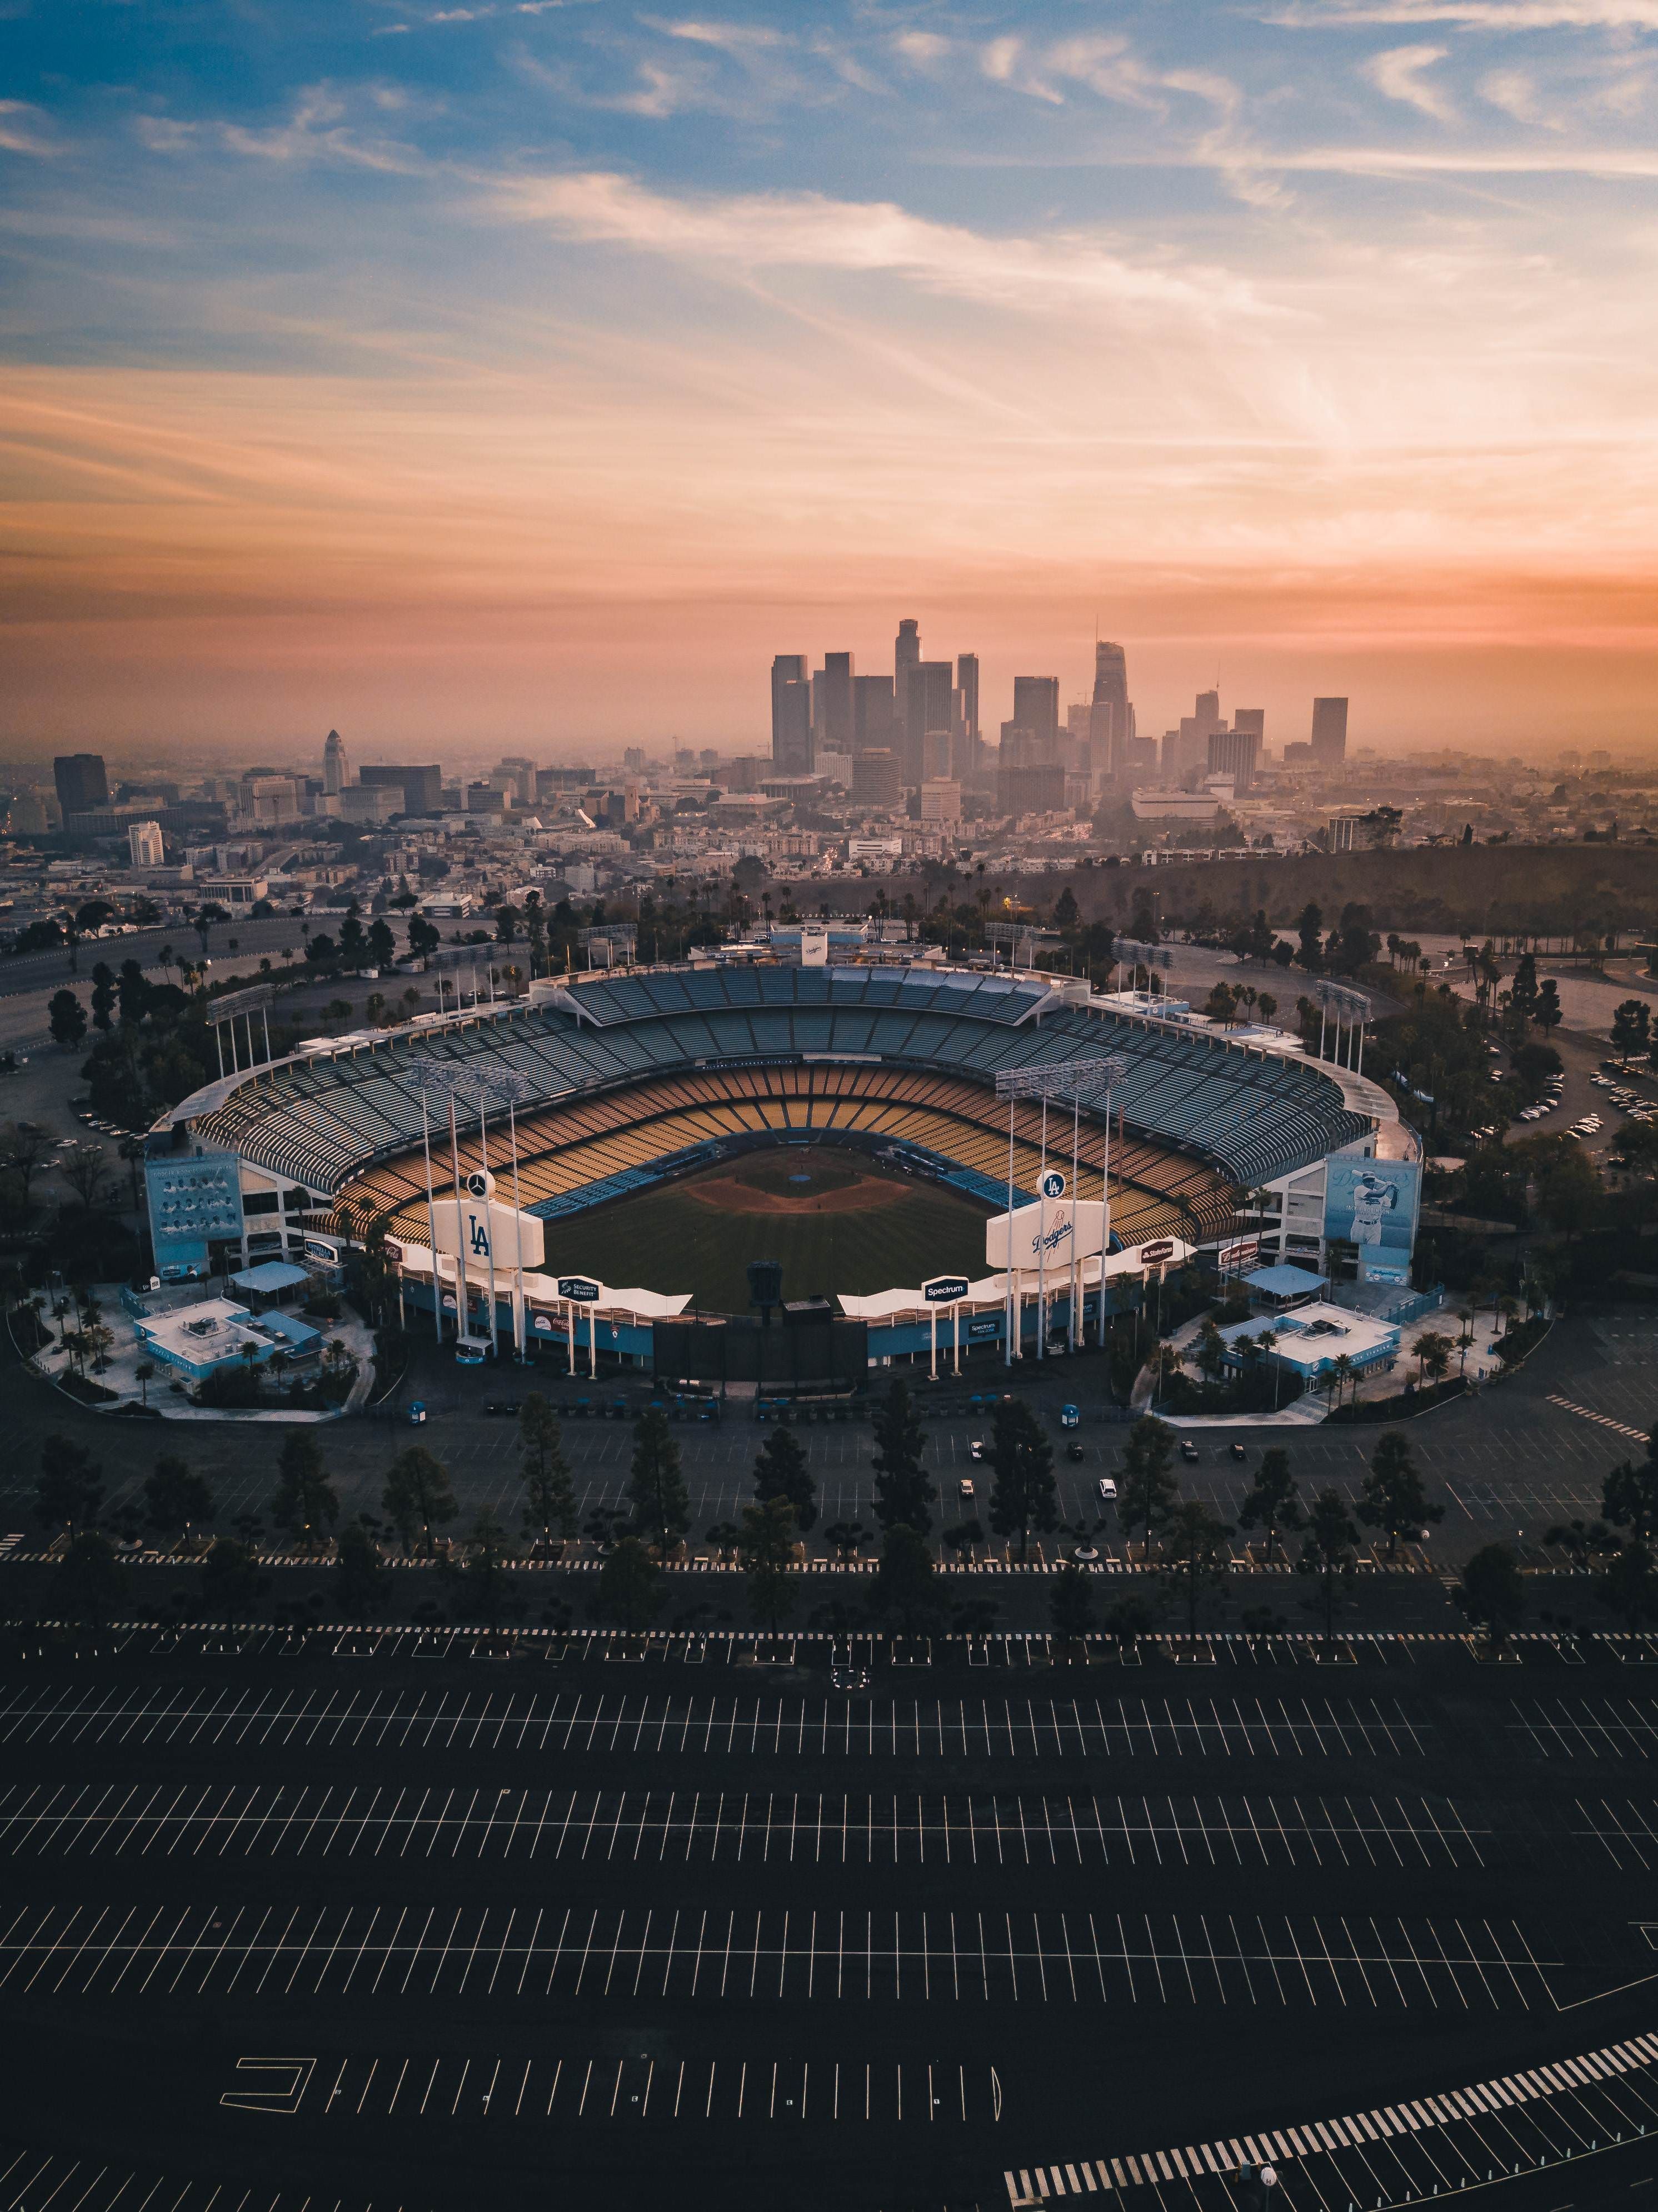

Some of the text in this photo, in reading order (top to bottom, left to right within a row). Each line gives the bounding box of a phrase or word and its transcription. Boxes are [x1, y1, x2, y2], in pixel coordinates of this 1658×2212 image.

[1048, 1177, 1060, 1195] LA
[468, 1215, 490, 1257] LA
[1032, 1221, 1075, 1254] Dodgers
[928, 1286, 963, 1296] Spectrum
